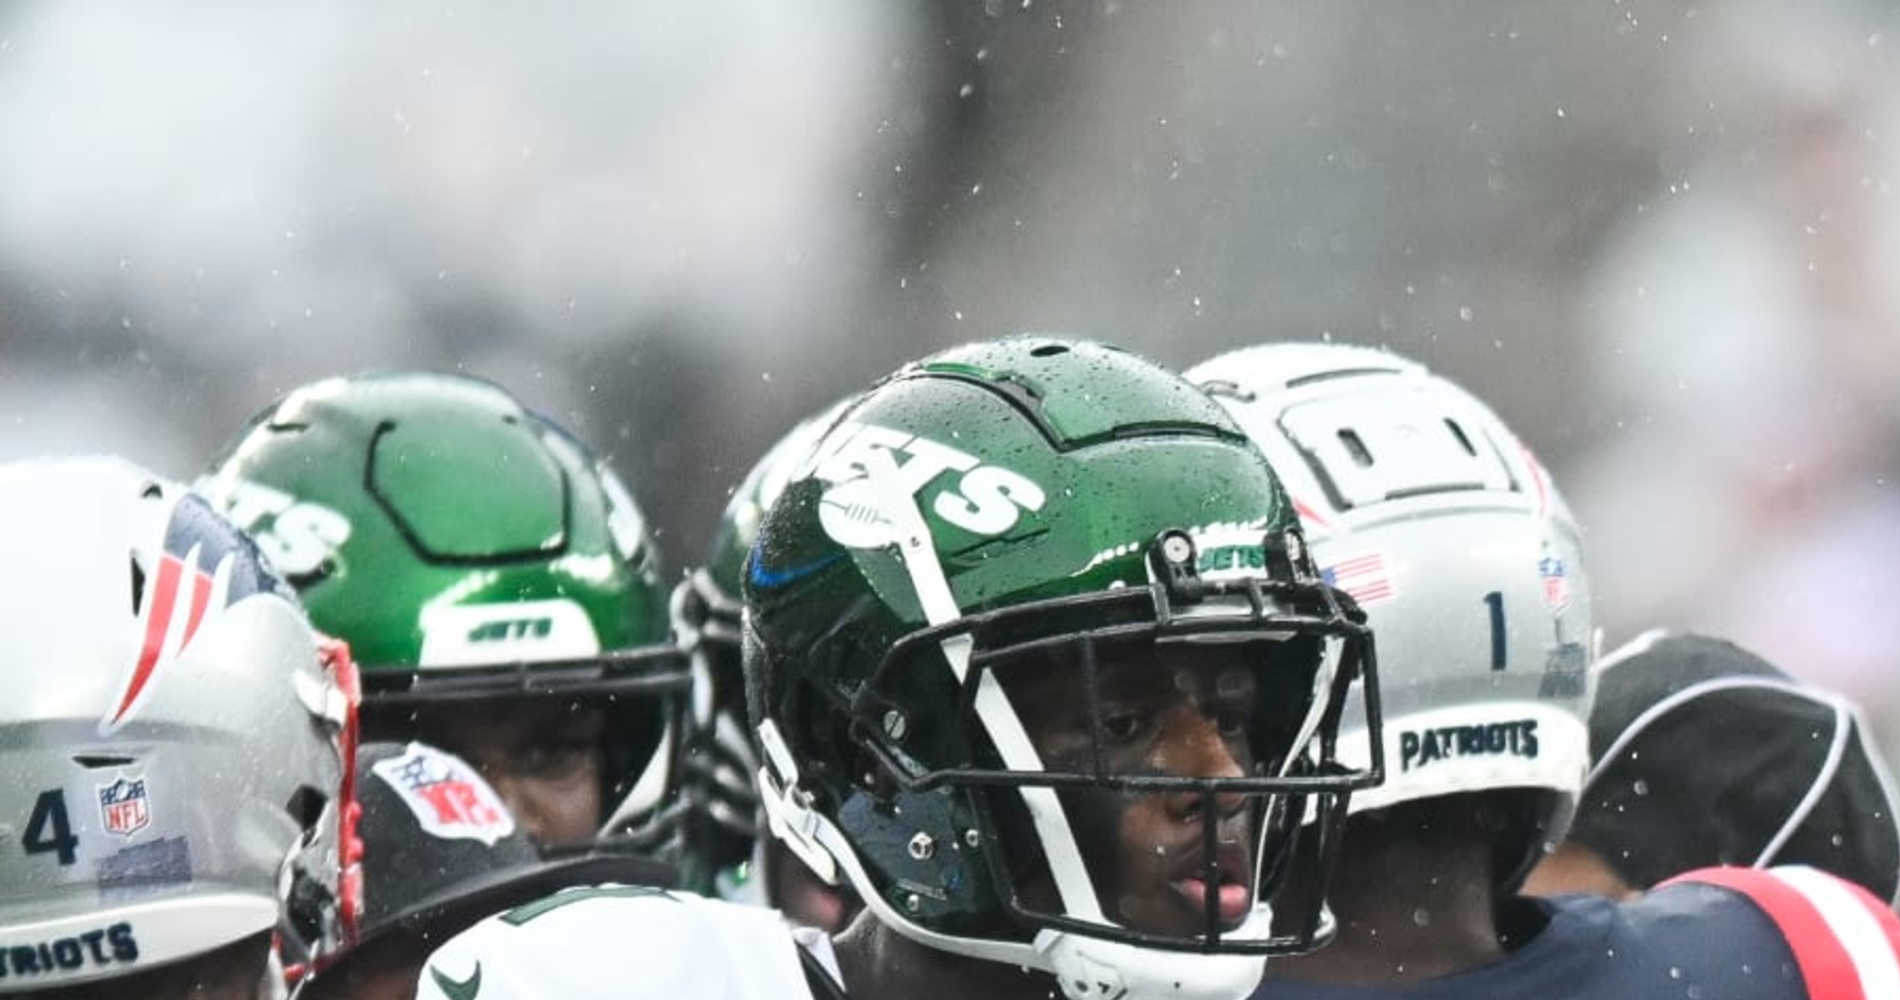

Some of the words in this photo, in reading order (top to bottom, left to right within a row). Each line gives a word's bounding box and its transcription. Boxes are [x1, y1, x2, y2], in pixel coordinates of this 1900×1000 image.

[1482, 591, 1507, 671] 1
[1399, 718, 1539, 773] PATRIOTS
[21, 787, 79, 867] 4
[105, 800, 146, 831] NFL
